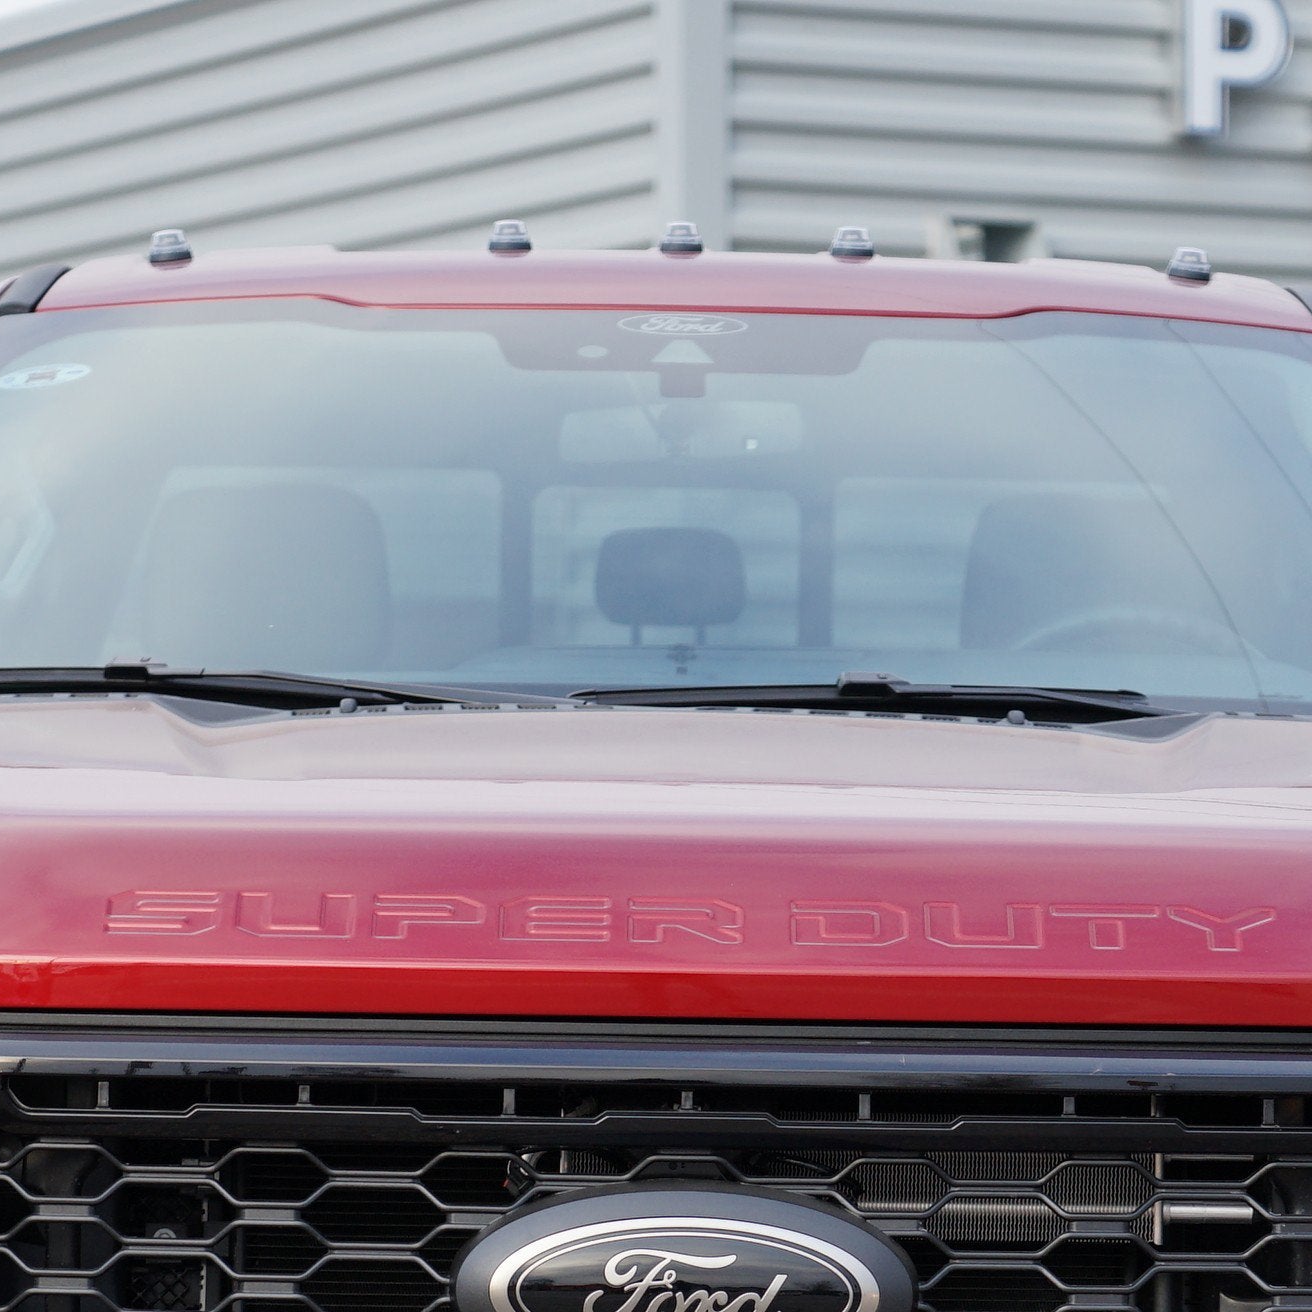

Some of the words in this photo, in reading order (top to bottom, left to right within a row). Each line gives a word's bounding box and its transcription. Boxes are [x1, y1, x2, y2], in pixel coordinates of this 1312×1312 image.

[640, 315, 726, 334] Ford
[102, 890, 745, 946] SUPER
[789, 899, 1278, 953] DUTY
